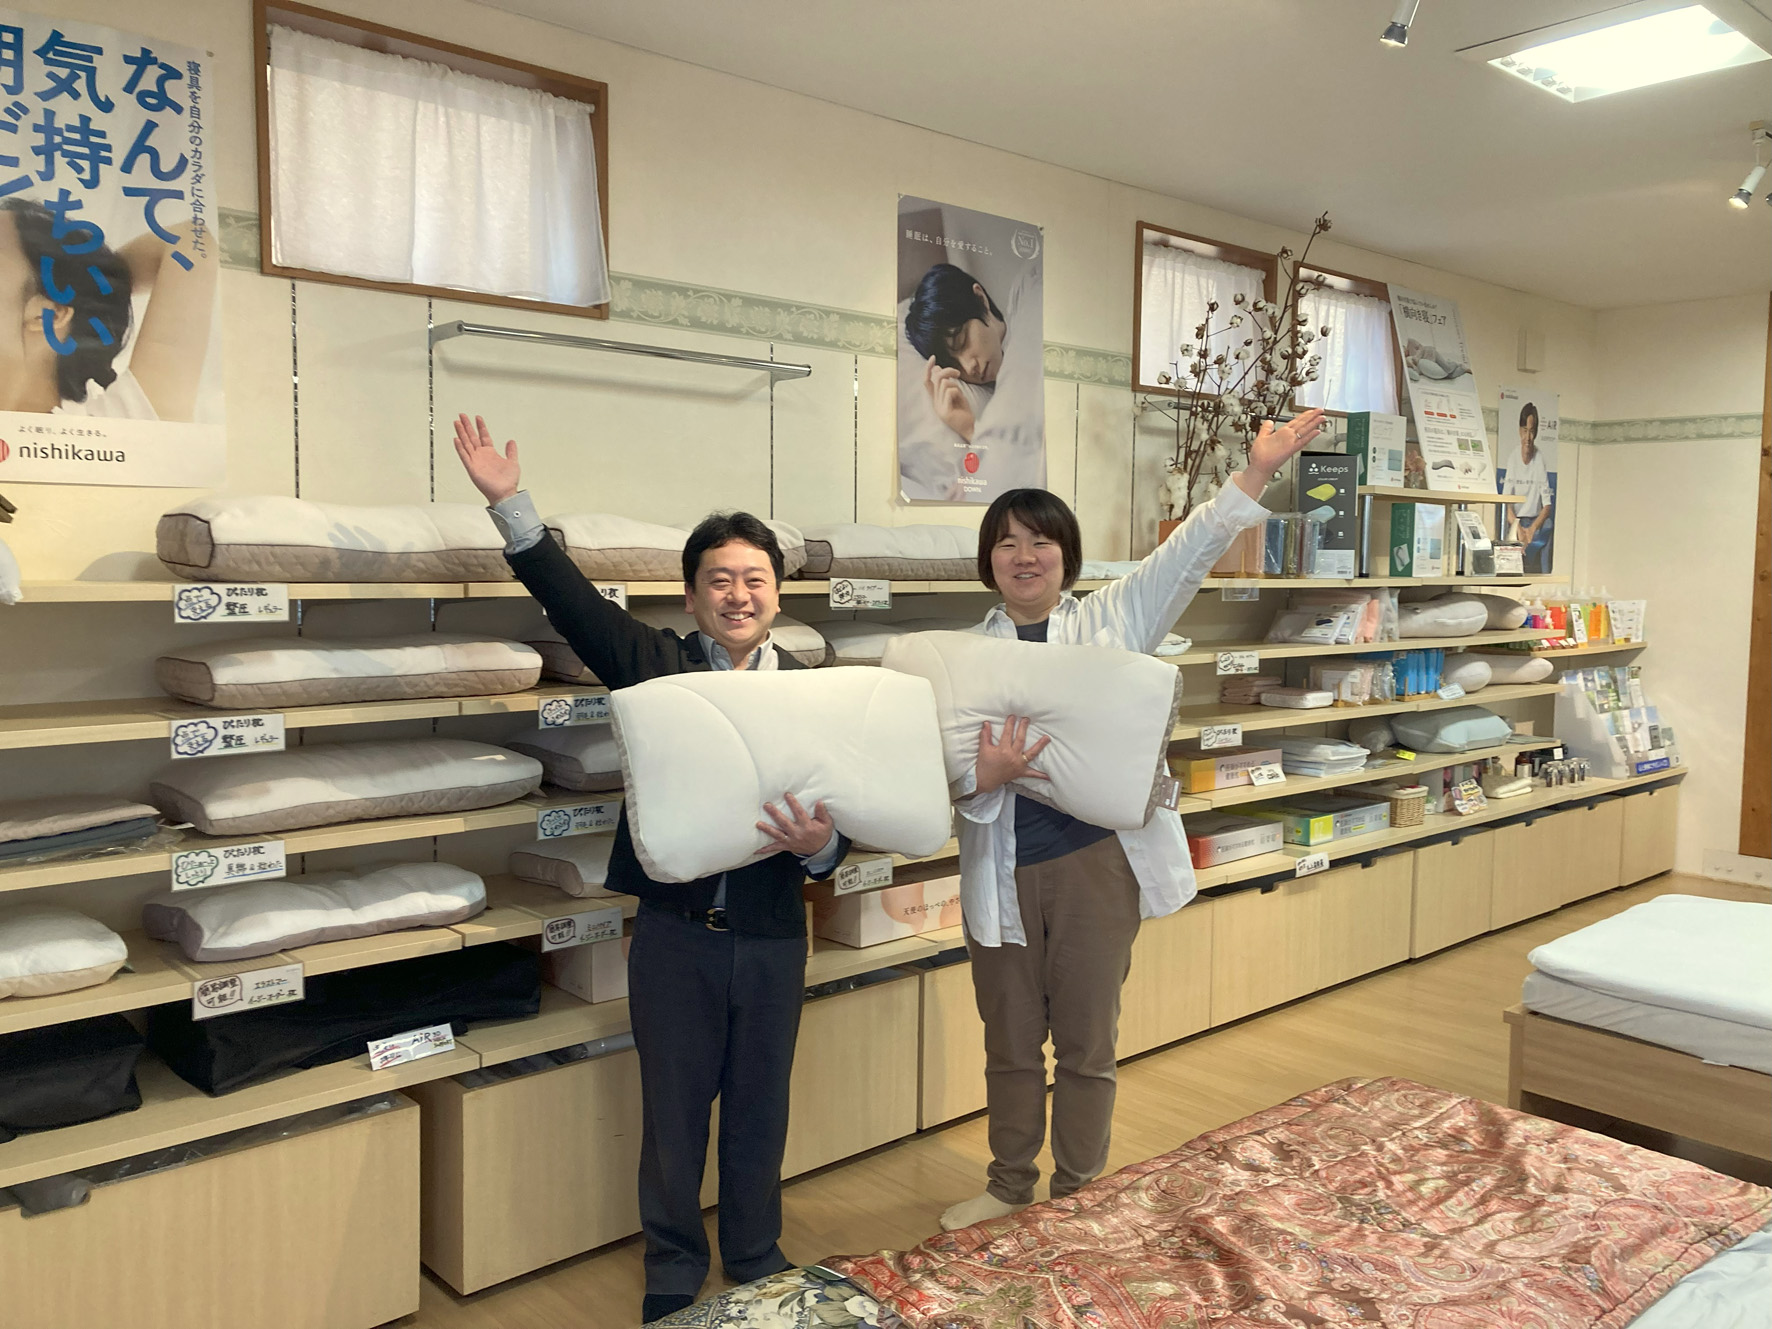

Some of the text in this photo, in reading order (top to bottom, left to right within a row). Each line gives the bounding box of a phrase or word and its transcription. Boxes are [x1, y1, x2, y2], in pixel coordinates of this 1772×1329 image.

[119, 46, 194, 272] なんて、
[186, 60, 208, 259] 寝具を自分のカラダに合わせた。
[31, 28, 116, 356] 気持ちいい
[905, 229, 993, 256] 睡眠は、自分を愛すること。
[18, 425, 107, 438] よく眠り、よく生きる。
[18, 442, 126, 462] nishikawa
[1320, 465, 1349, 474] Keeps
